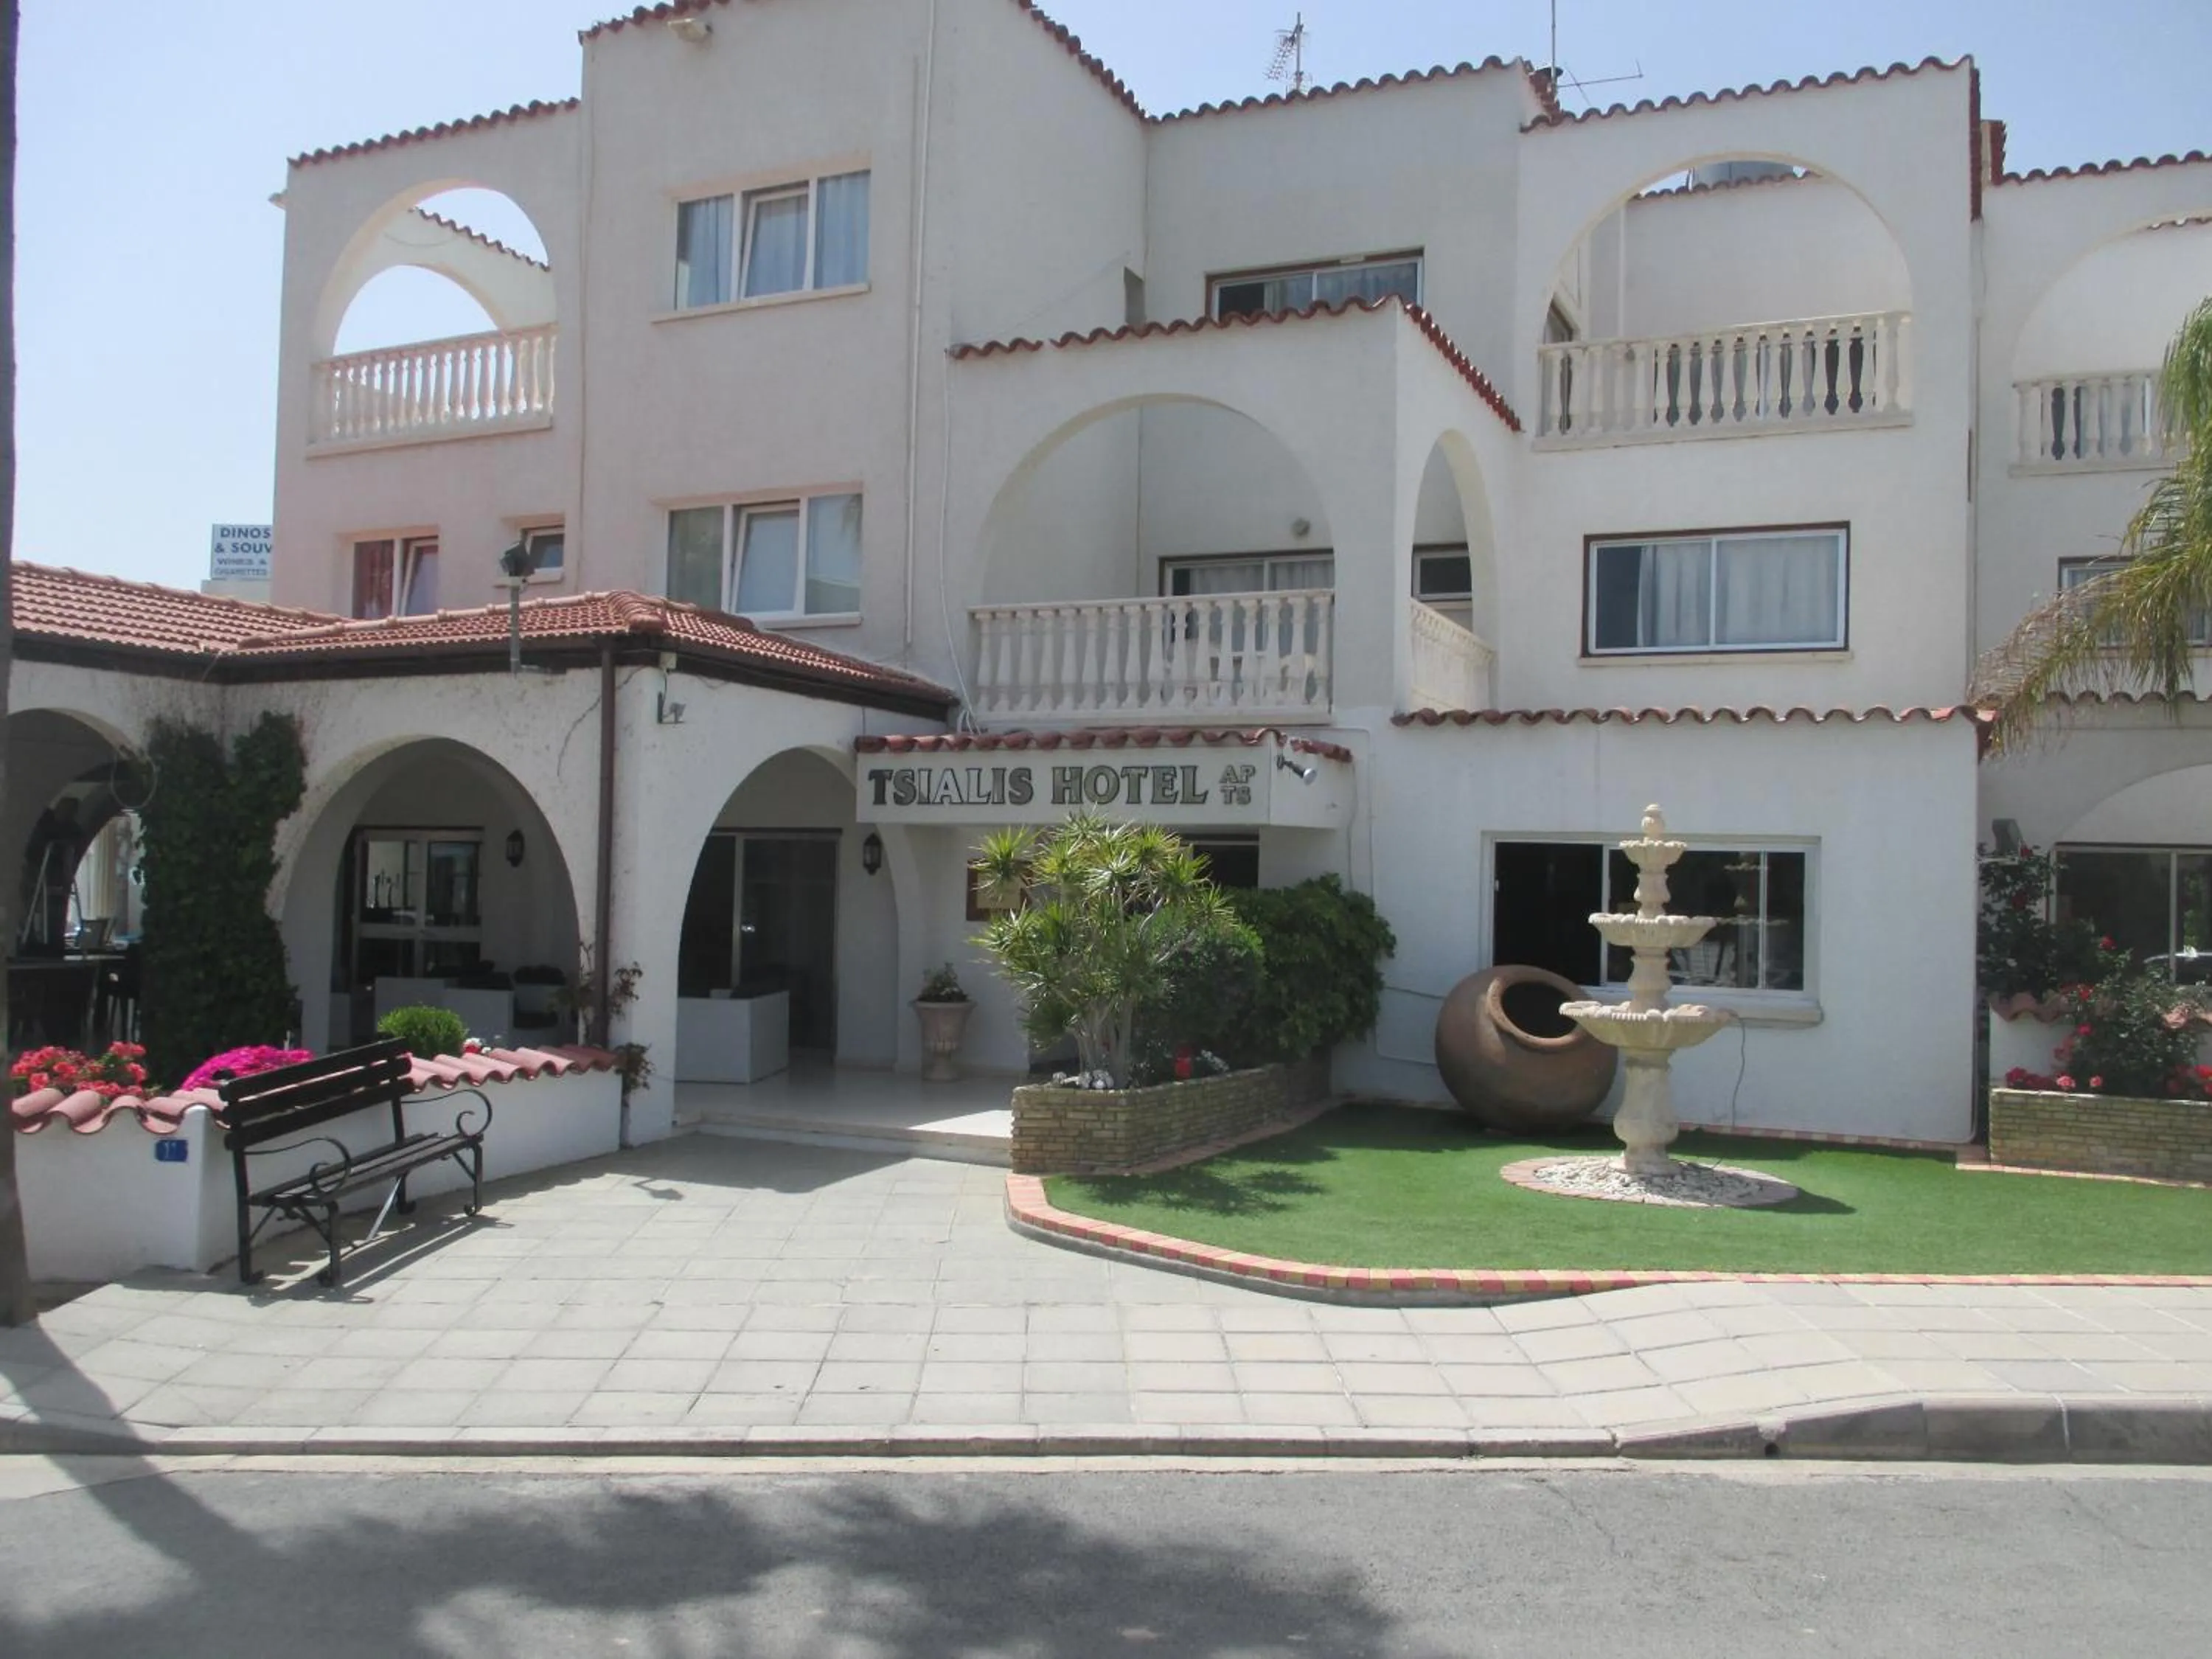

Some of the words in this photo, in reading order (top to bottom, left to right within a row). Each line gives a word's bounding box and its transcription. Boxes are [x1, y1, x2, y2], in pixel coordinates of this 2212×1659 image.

[220, 527, 271, 539] DINOS
[215, 542, 225, 553] &
[1219, 765, 1256, 784] AP
[868, 767, 1034, 805] TSIALIS
[1051, 765, 1209, 805] HOTEL
[1220, 785, 1252, 805] TS
